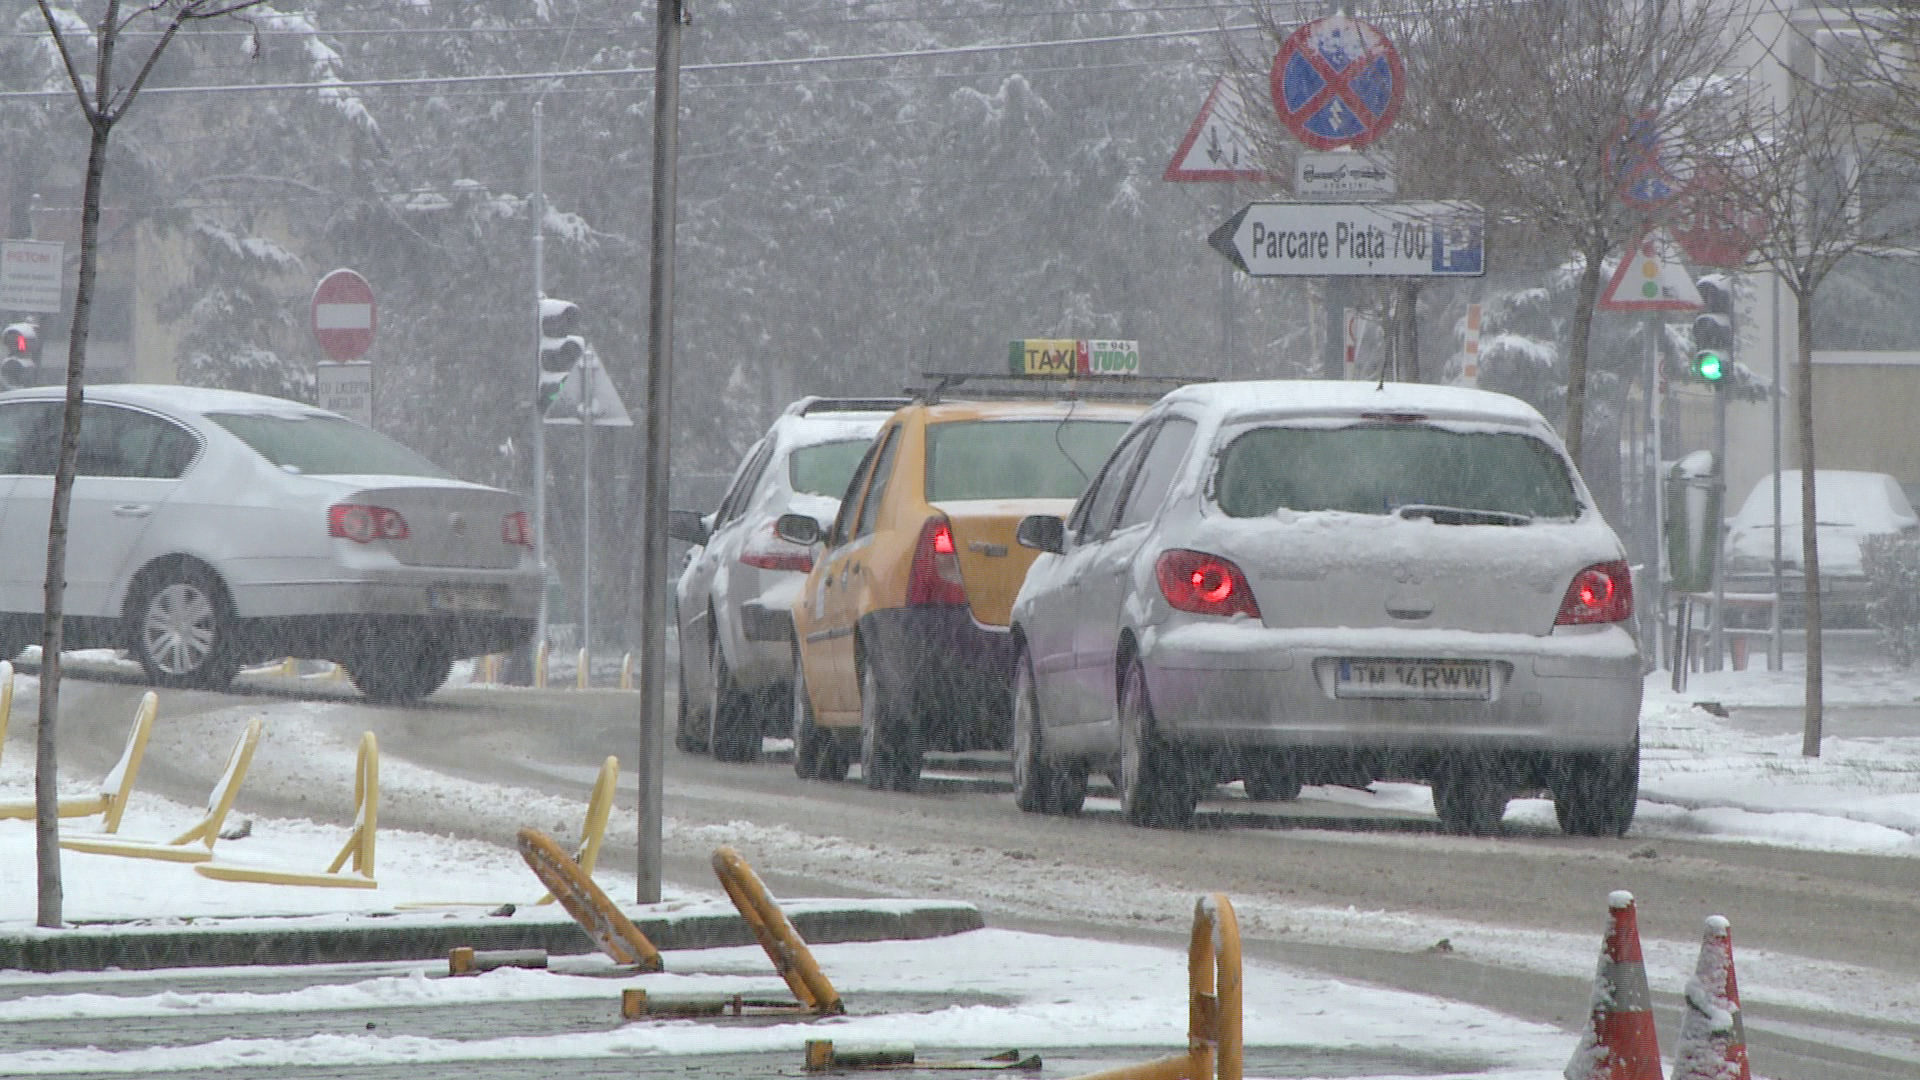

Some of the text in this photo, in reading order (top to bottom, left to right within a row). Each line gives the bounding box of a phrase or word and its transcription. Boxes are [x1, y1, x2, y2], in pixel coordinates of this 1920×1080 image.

[1252, 221, 1329, 259] Parcare
[1392, 222, 1426, 260] 700
[1025, 349, 1076, 371] TAXI
[1094, 350, 1138, 371] TUDO
[1353, 666, 1385, 684] TM
[1423, 667, 1483, 689] RWW
